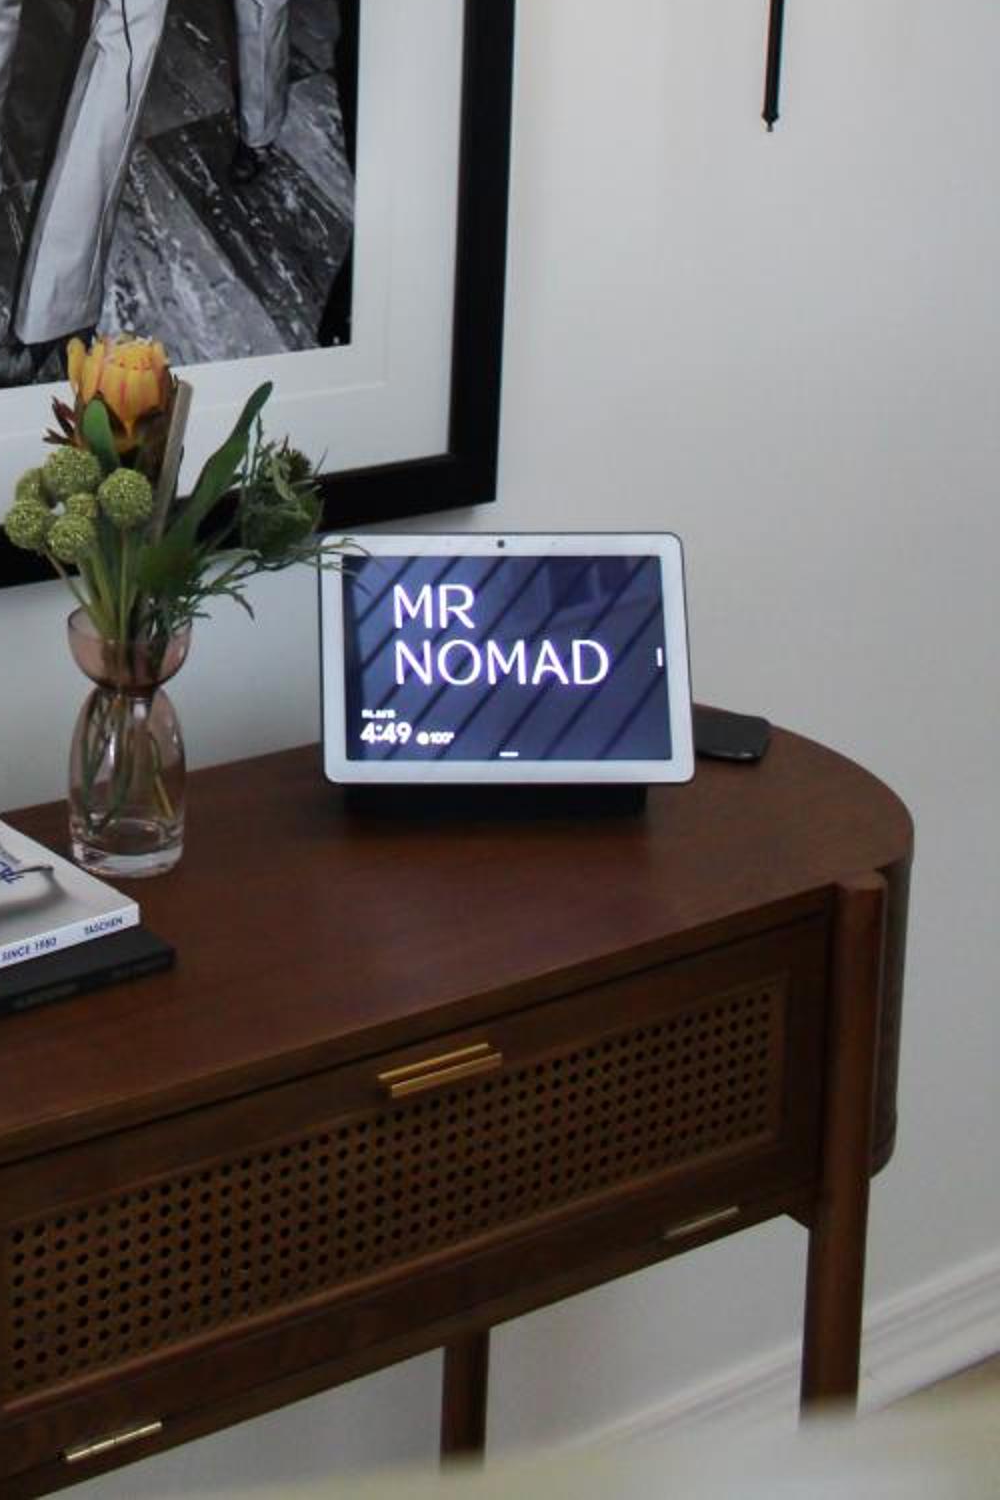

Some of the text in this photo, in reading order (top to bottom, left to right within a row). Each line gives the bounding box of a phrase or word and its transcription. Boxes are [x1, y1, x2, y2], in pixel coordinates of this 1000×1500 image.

[393, 584, 475, 629] MR
[395, 640, 609, 685] NOMAD
[360, 722, 412, 744] 4:49
[84, 916, 124, 935] TASCHEN
[1, 944, 31, 963] SINCE
[35, 937, 57, 952] 1980
